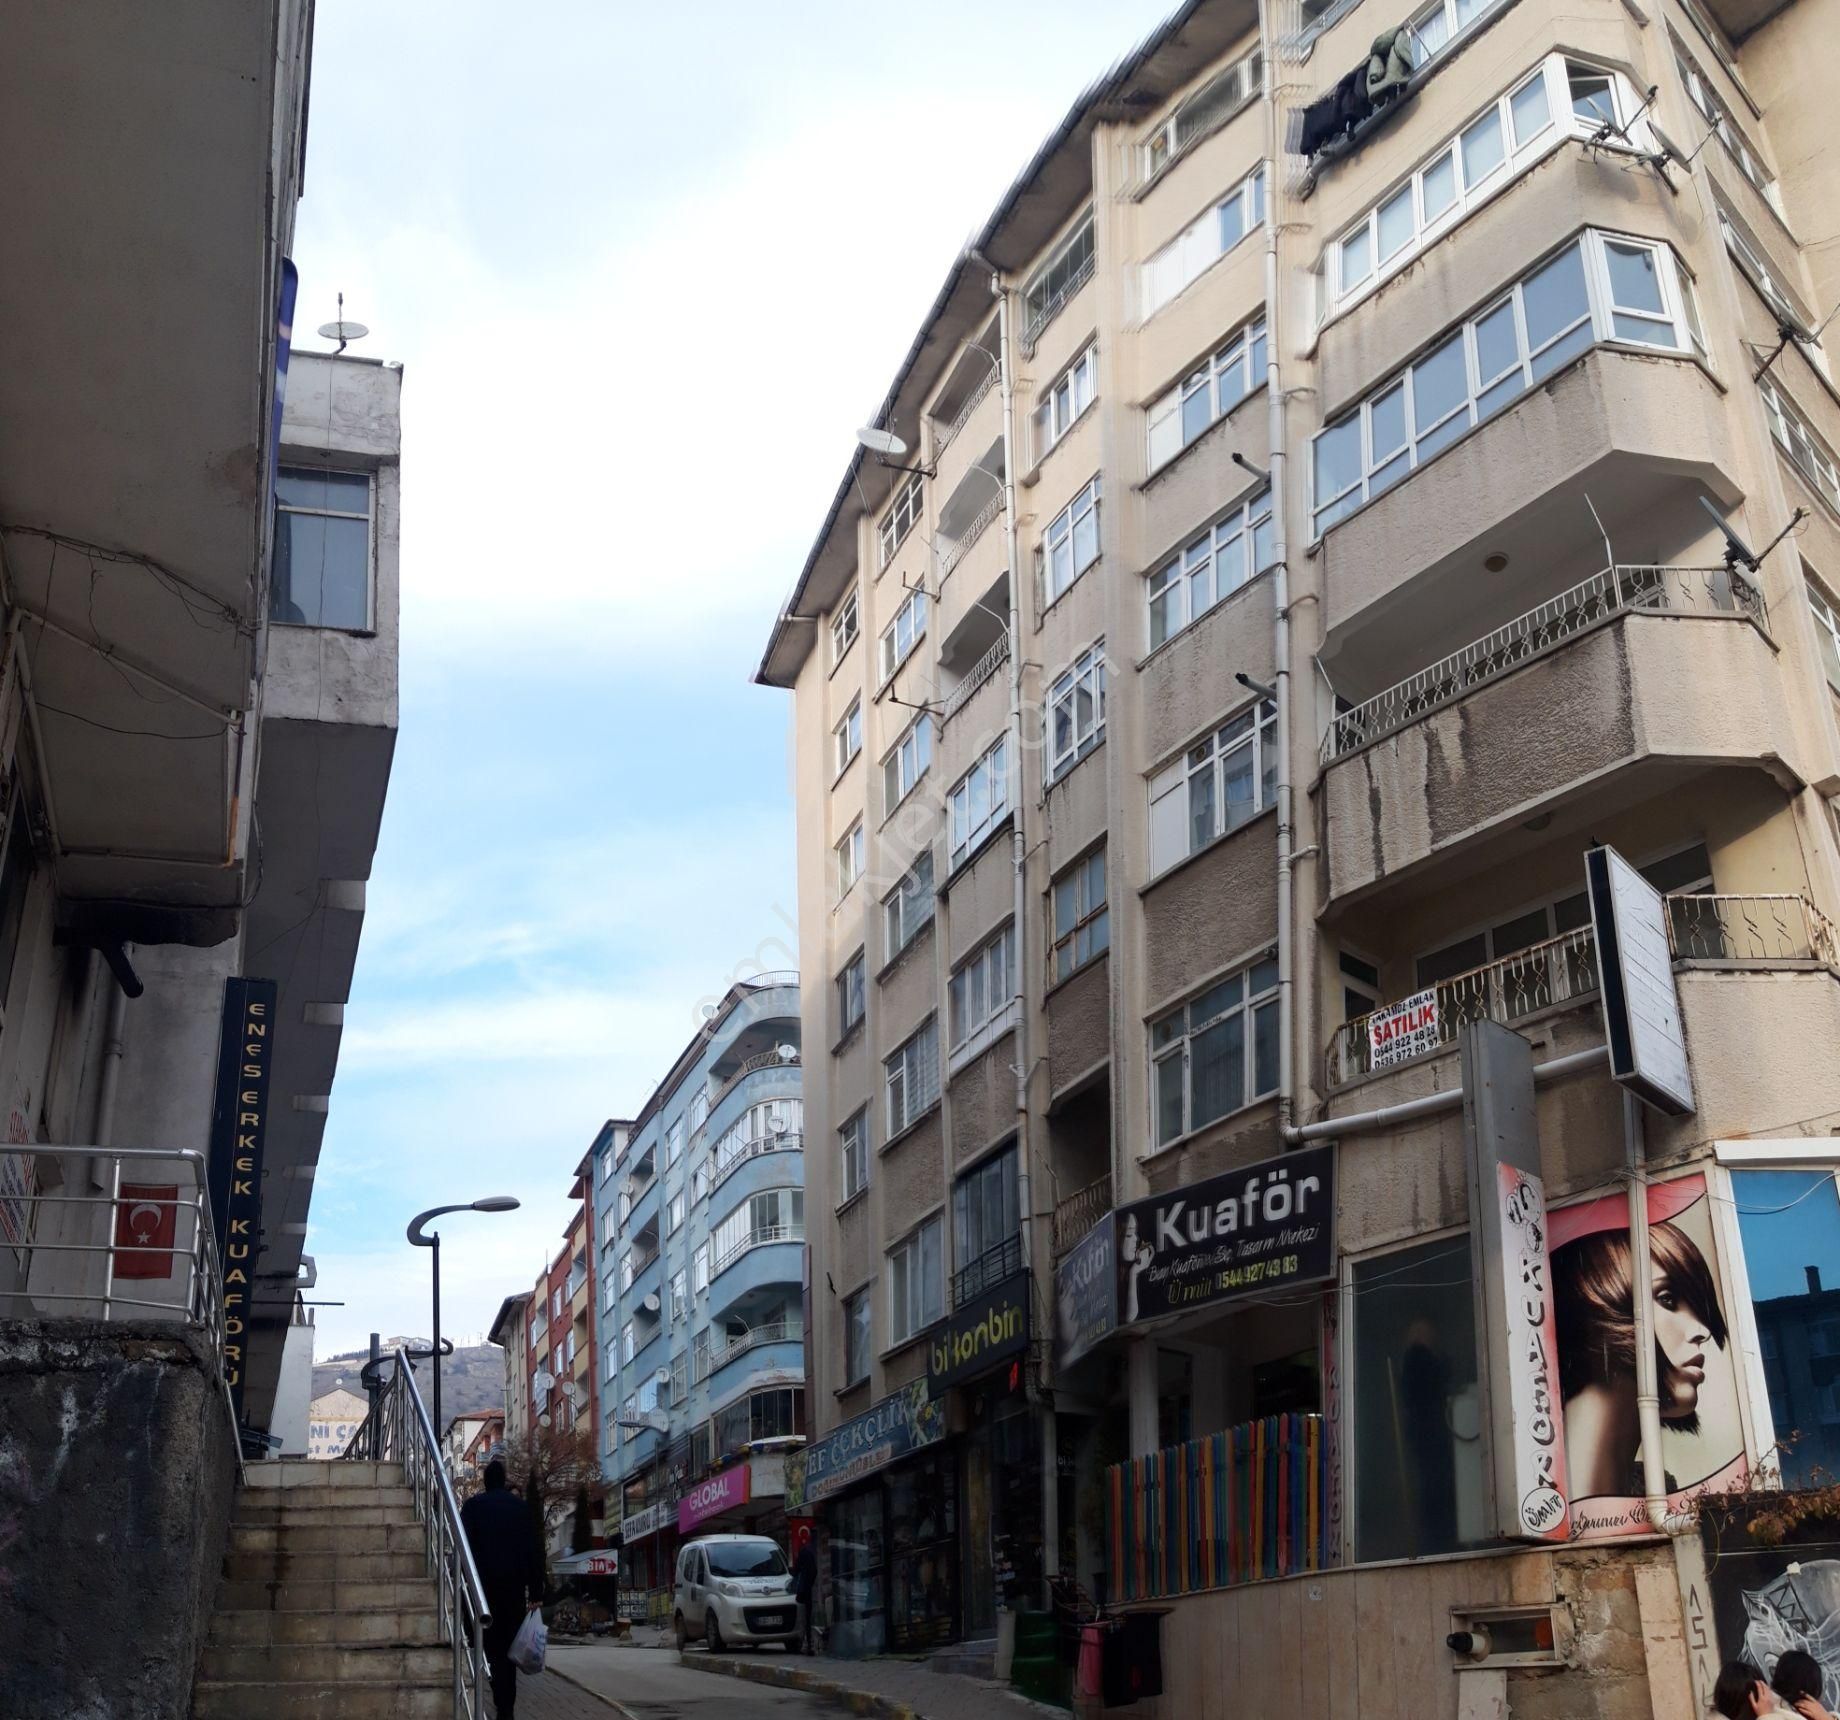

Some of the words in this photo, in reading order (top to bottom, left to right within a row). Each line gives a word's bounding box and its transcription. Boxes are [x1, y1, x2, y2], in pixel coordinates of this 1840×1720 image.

[243, 1003, 266, 1079] ENES
[1373, 1004, 1435, 1046] SATILIK
[1374, 1043, 1393, 1058] 0544
[1395, 1036, 1411, 1049] 922
[1414, 1030, 1425, 1041] 48
[1396, 1048, 1412, 1062] 972
[1415, 1043, 1426, 1054] 60
[1428, 1037, 1438, 1049] 97
[234, 1089, 260, 1196] ERKEK
[1156, 1169, 1320, 1253] Kuaför
[224, 1219, 251, 1387] KUAFÖRÜ
[689, 1476, 731, 1511] GLOBAL
